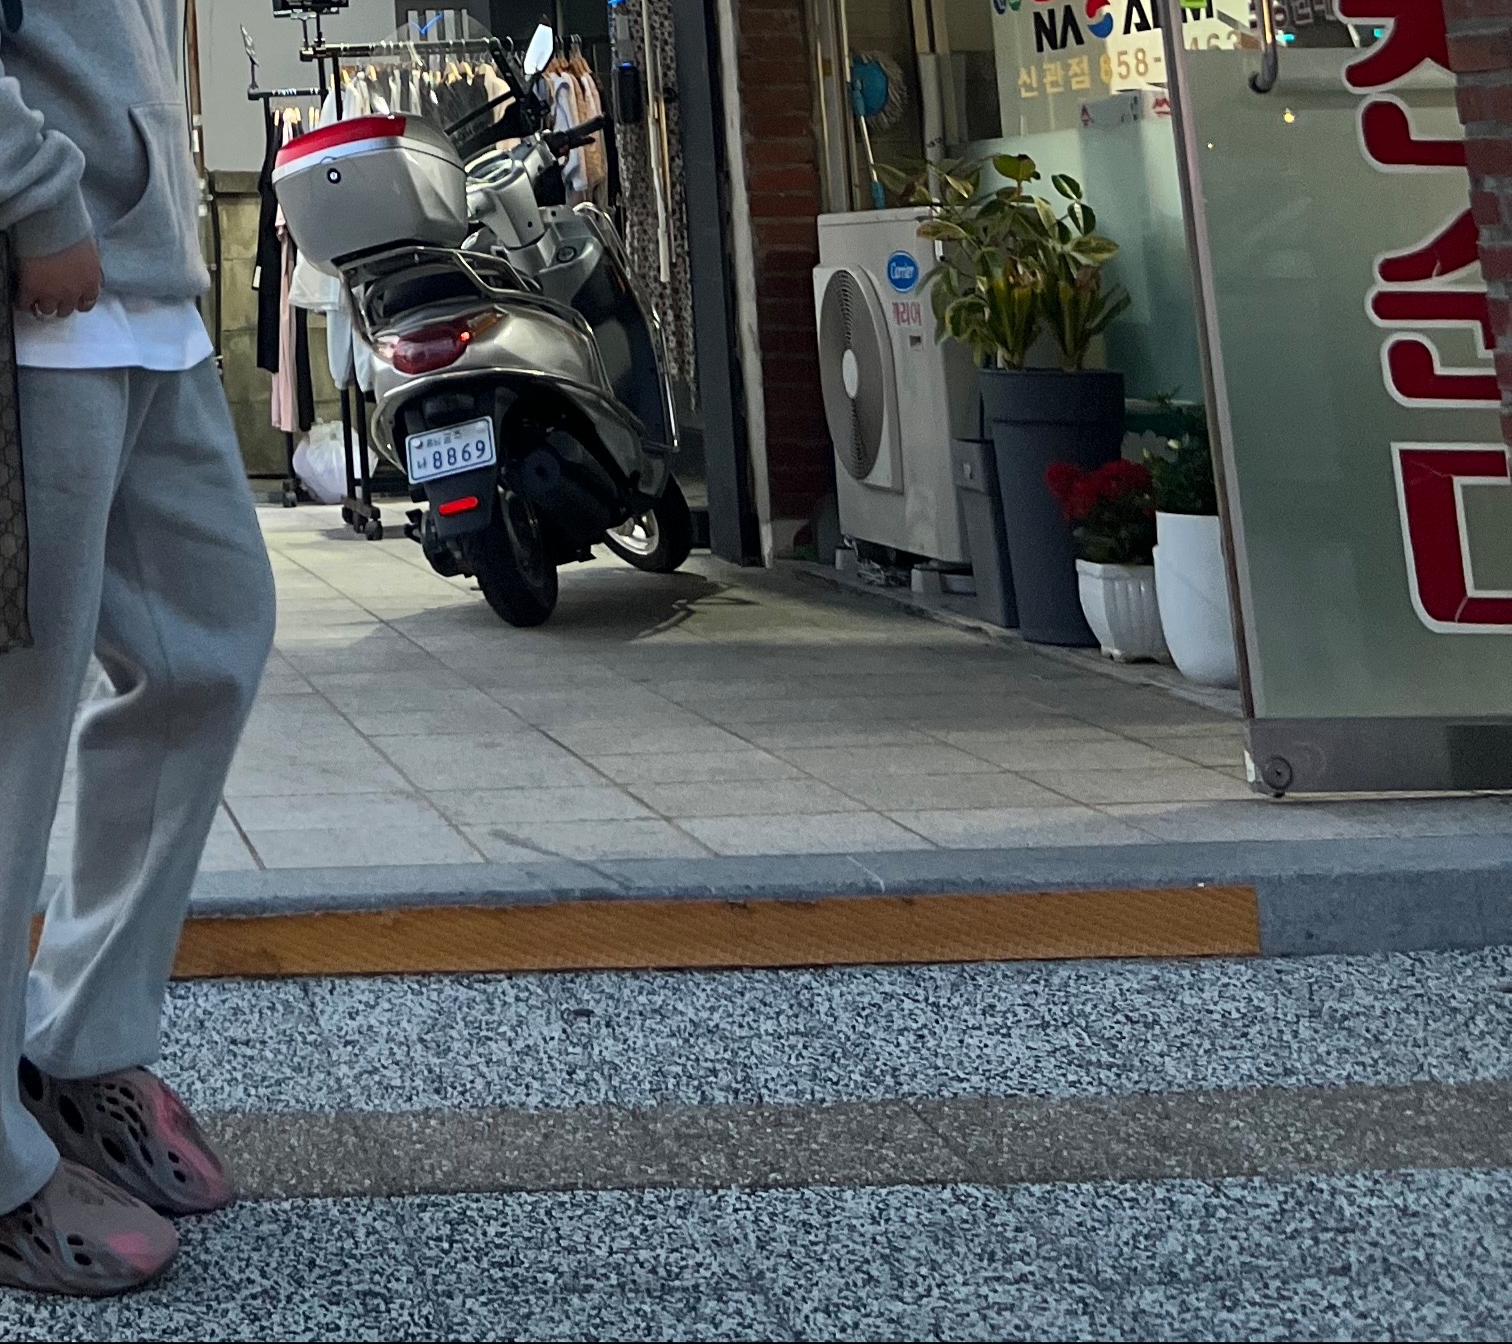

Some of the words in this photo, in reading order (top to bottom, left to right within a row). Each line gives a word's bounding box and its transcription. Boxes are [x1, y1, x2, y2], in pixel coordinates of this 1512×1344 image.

[1017, 55, 1092, 99] 신관점
[890, 261, 915, 280] Carrier
[432, 439, 486, 470] 8869
